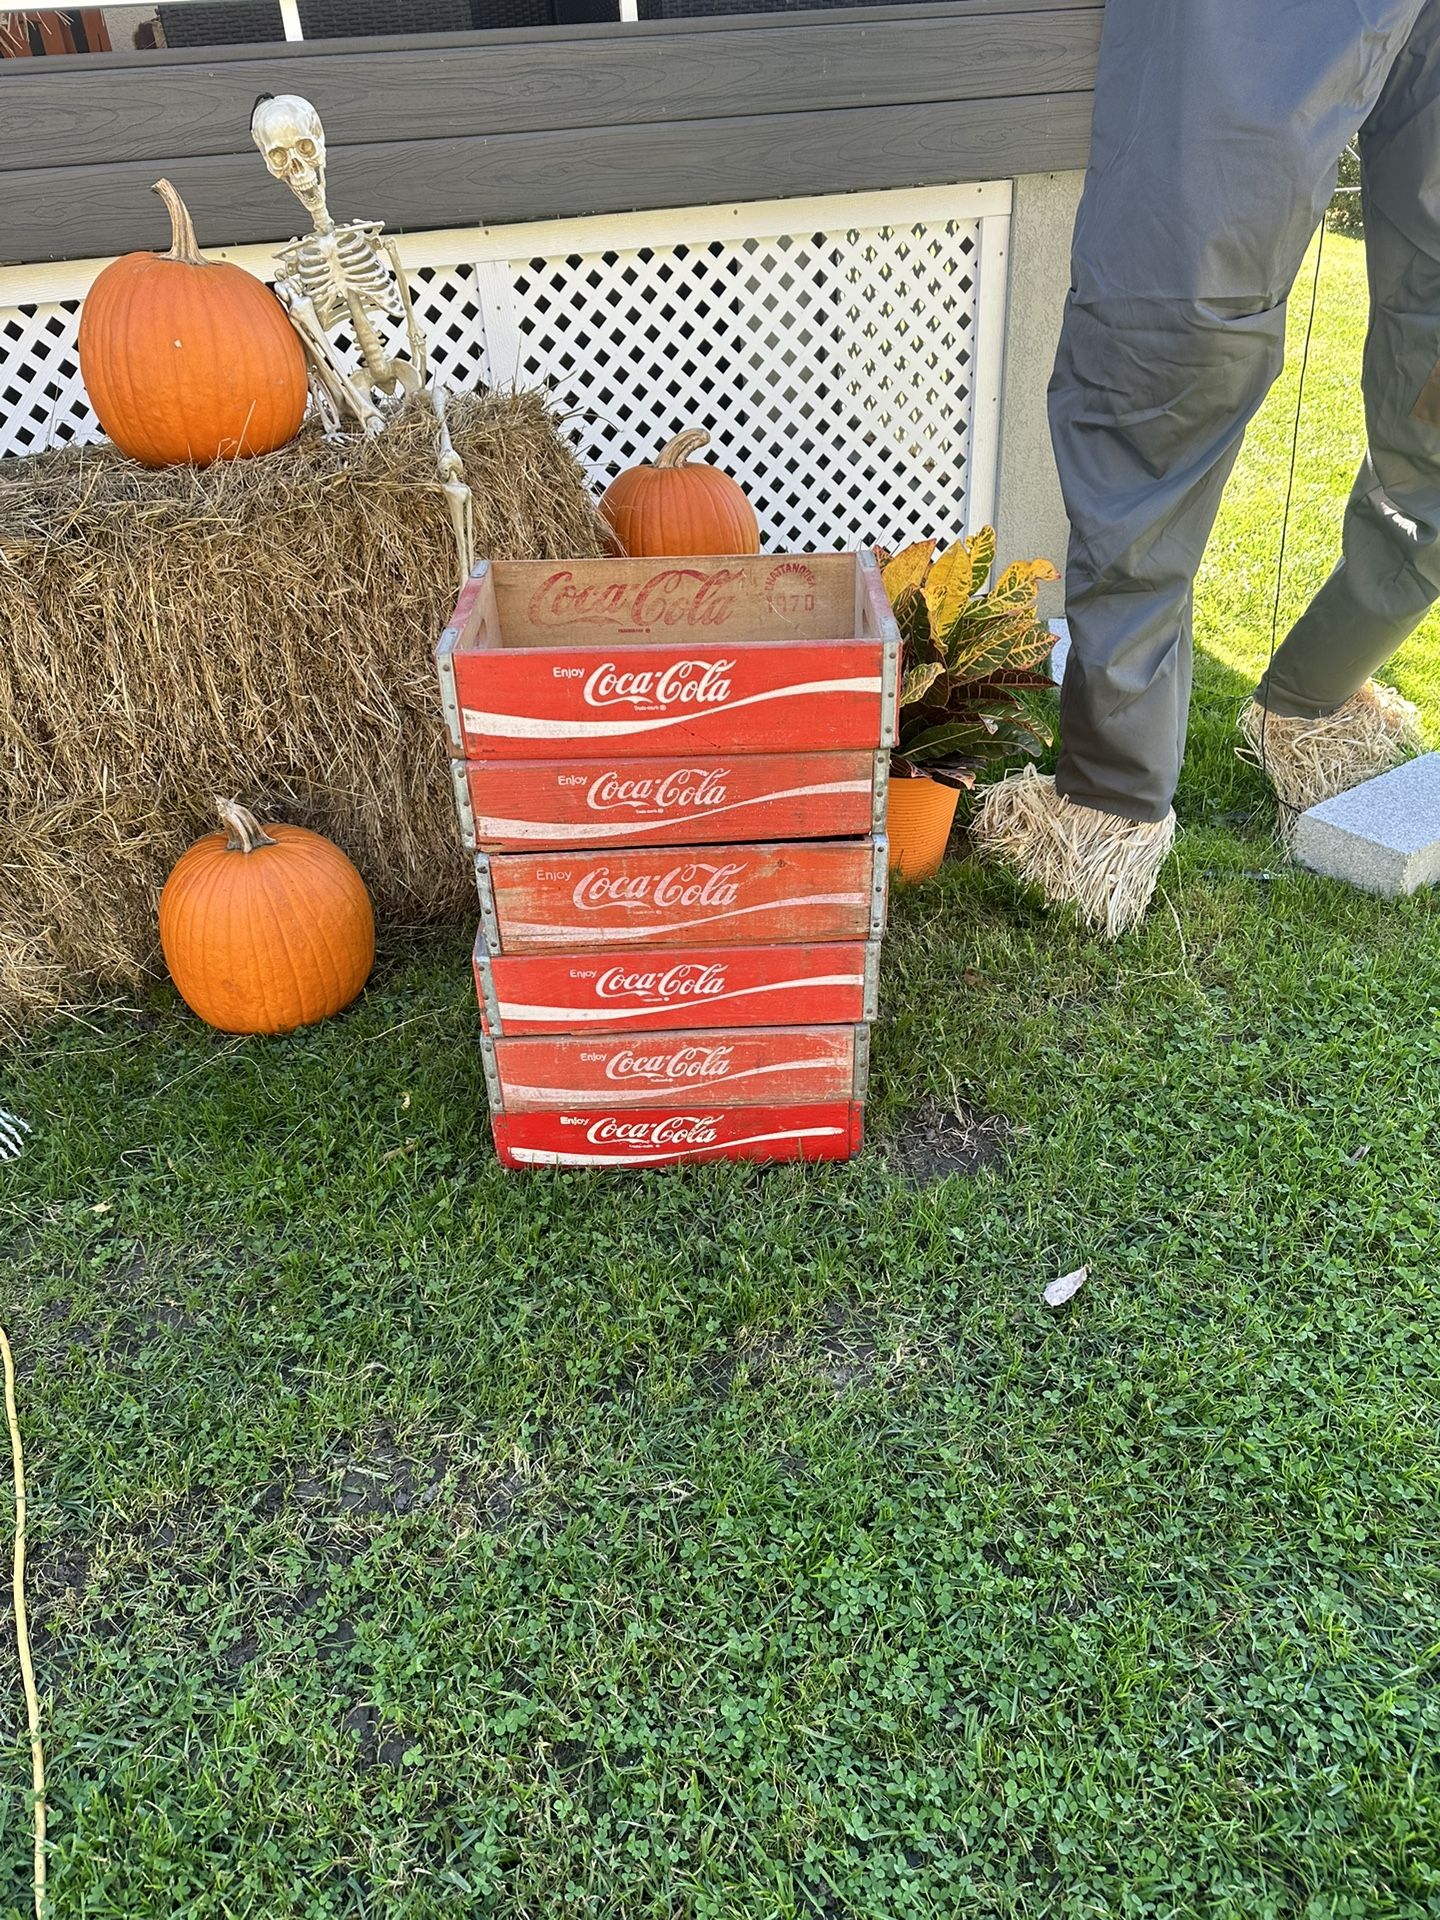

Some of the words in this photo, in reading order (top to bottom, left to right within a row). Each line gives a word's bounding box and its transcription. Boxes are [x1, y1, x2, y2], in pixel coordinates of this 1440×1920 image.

[528, 568, 745, 628] Coca-Cola
[766, 593, 815, 613] 1970
[553, 667, 585, 679] Enjoy
[583, 659, 737, 707] Coca-Cola
[557, 775, 588, 786] Enjoy
[587, 768, 731, 810] Coca-Cola
[536, 869, 572, 881] Enjoy
[572, 862, 749, 911] Coca-Cola
[570, 969, 597, 979] Enjoy
[595, 963, 729, 998] Coca-Cola
[580, 1053, 607, 1062] Enjoy
[605, 1046, 735, 1080] Coca-Cola
[560, 1116, 590, 1126] Enjoy
[586, 1114, 725, 1145] Coca-Cola
